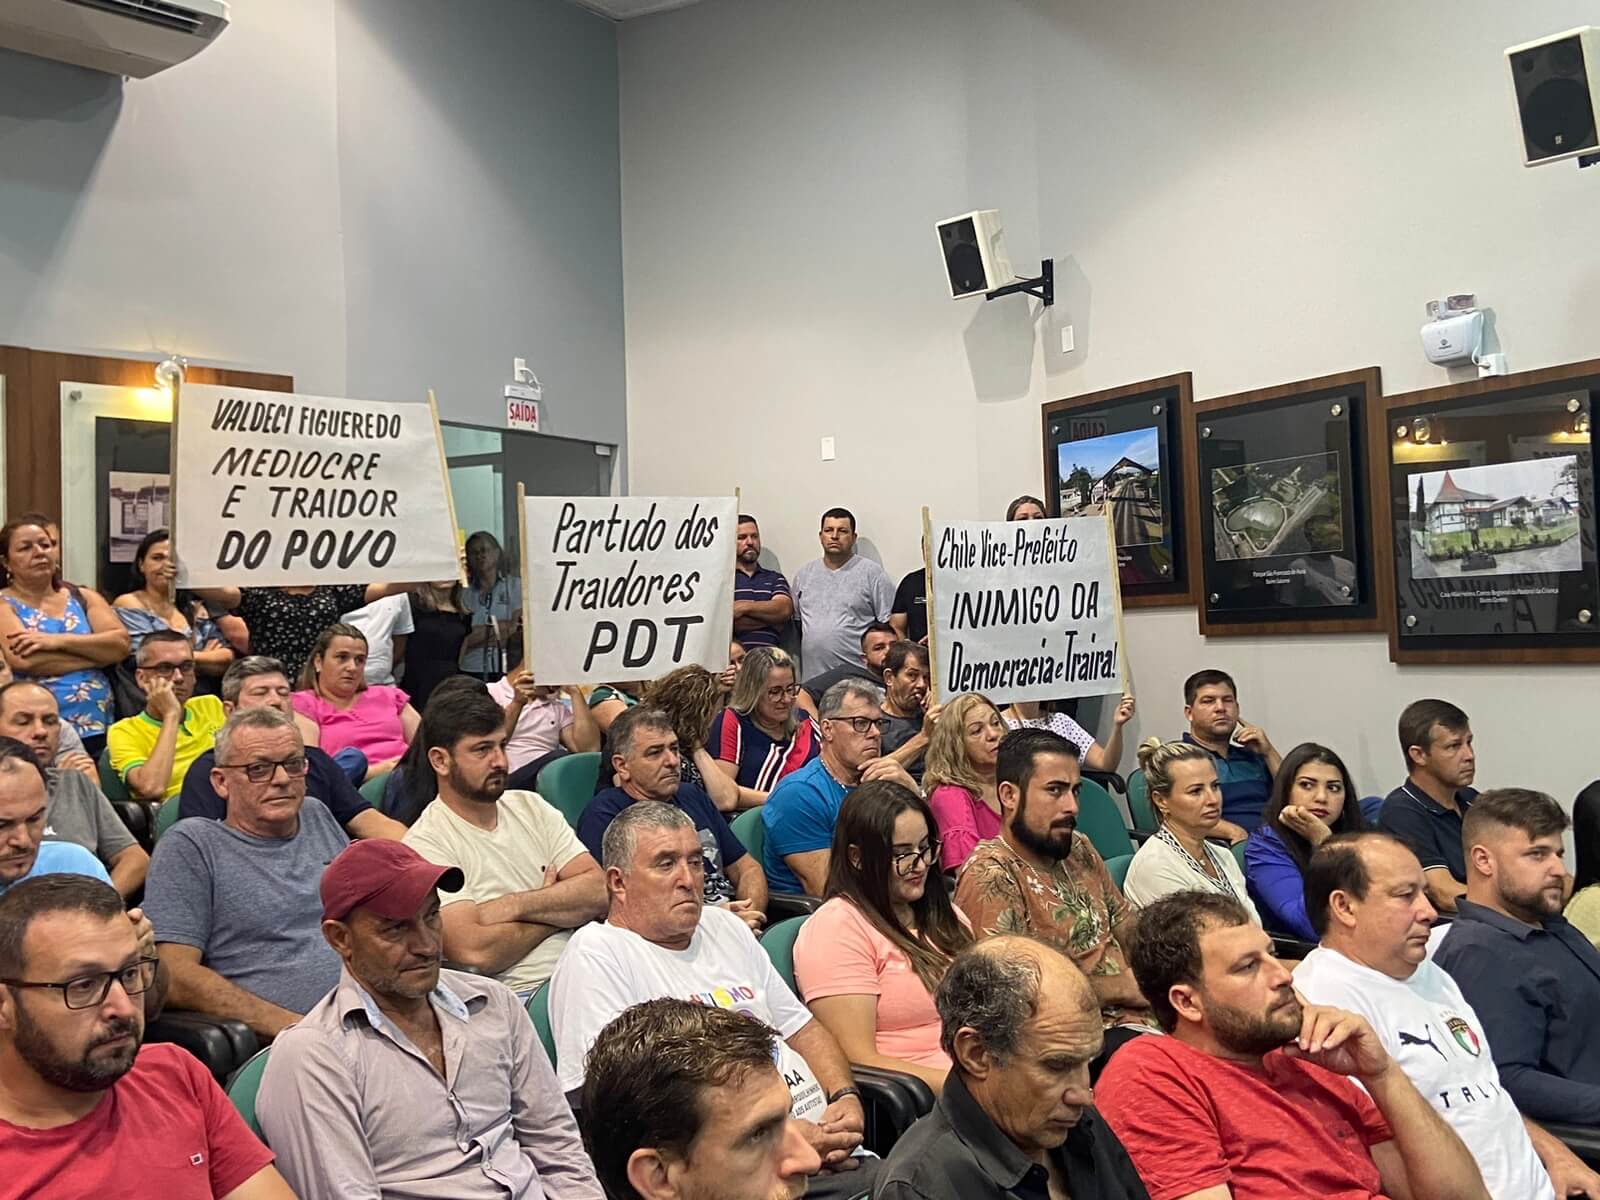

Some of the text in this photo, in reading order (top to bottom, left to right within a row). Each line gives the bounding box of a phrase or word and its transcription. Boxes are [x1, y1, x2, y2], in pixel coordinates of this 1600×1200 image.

[211, 398, 401, 439] VALDECI FIGUEREDO
[509, 401, 537, 422] SAÍDA
[211, 446, 381, 481] MEDIOCRE
[221, 484, 398, 519] E TRAIDOR
[552, 502, 719, 554] Partido dos
[937, 524, 1078, 571] Chile Vice-Prefeito
[216, 529, 397, 570] DO POVO
[551, 559, 700, 612] Traidores
[950, 580, 1100, 630] INIMIGO DA
[583, 615, 704, 673] PDT
[1440, 1081, 1500, 1109] TALI
